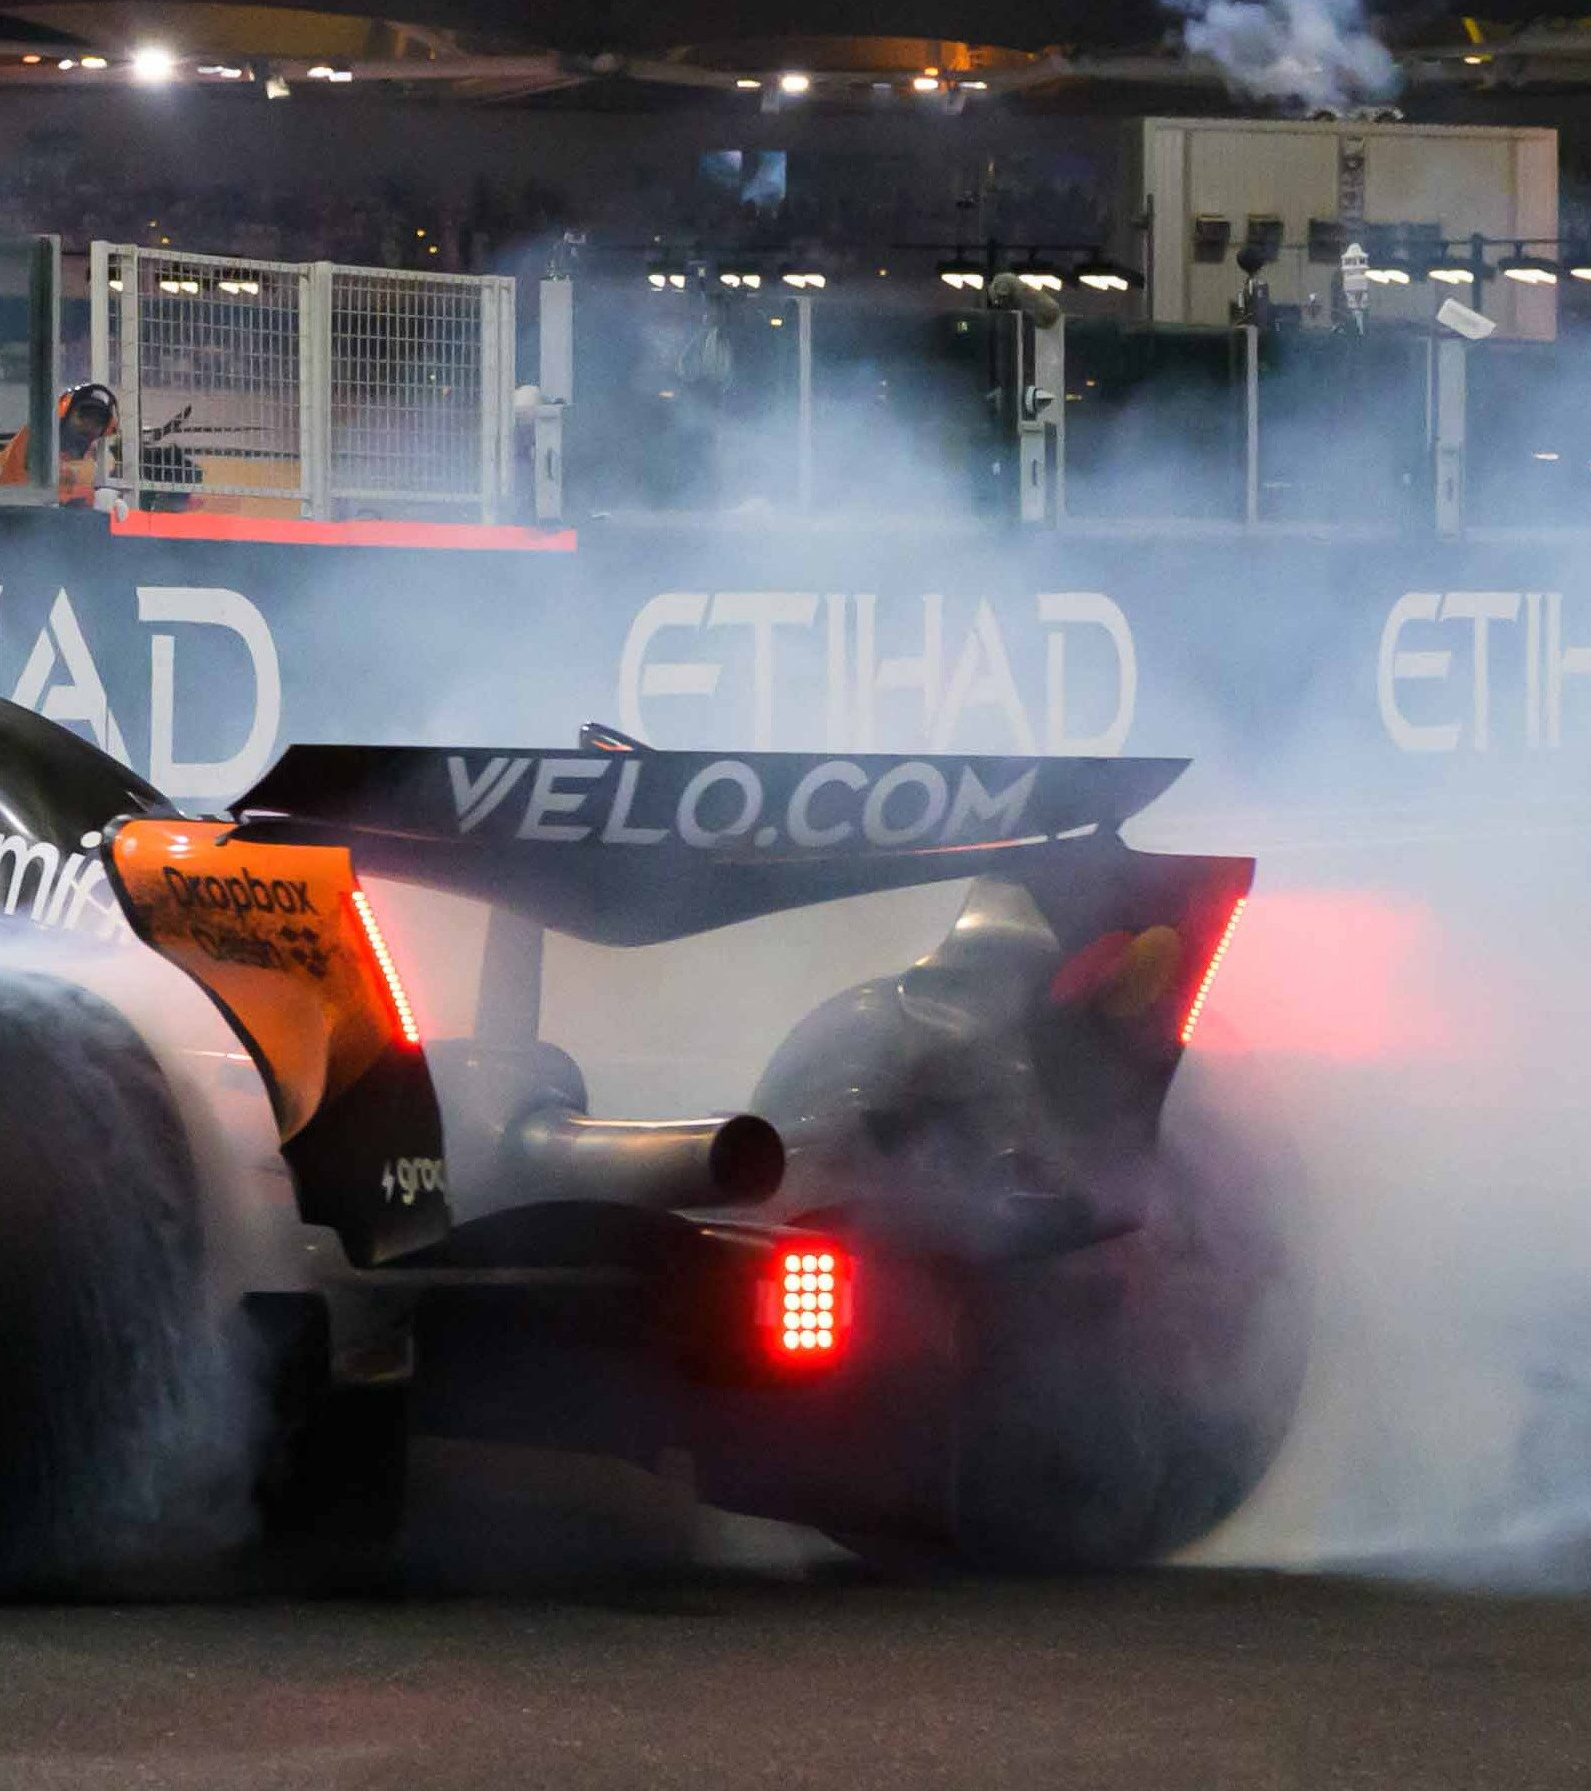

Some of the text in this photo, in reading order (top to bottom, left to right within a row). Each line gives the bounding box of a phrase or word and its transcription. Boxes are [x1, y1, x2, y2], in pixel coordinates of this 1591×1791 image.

[618, 592, 1138, 757] ETIHAD
[447, 755, 1040, 849] VELO.COM
[163, 865, 320, 924] Dropbox
